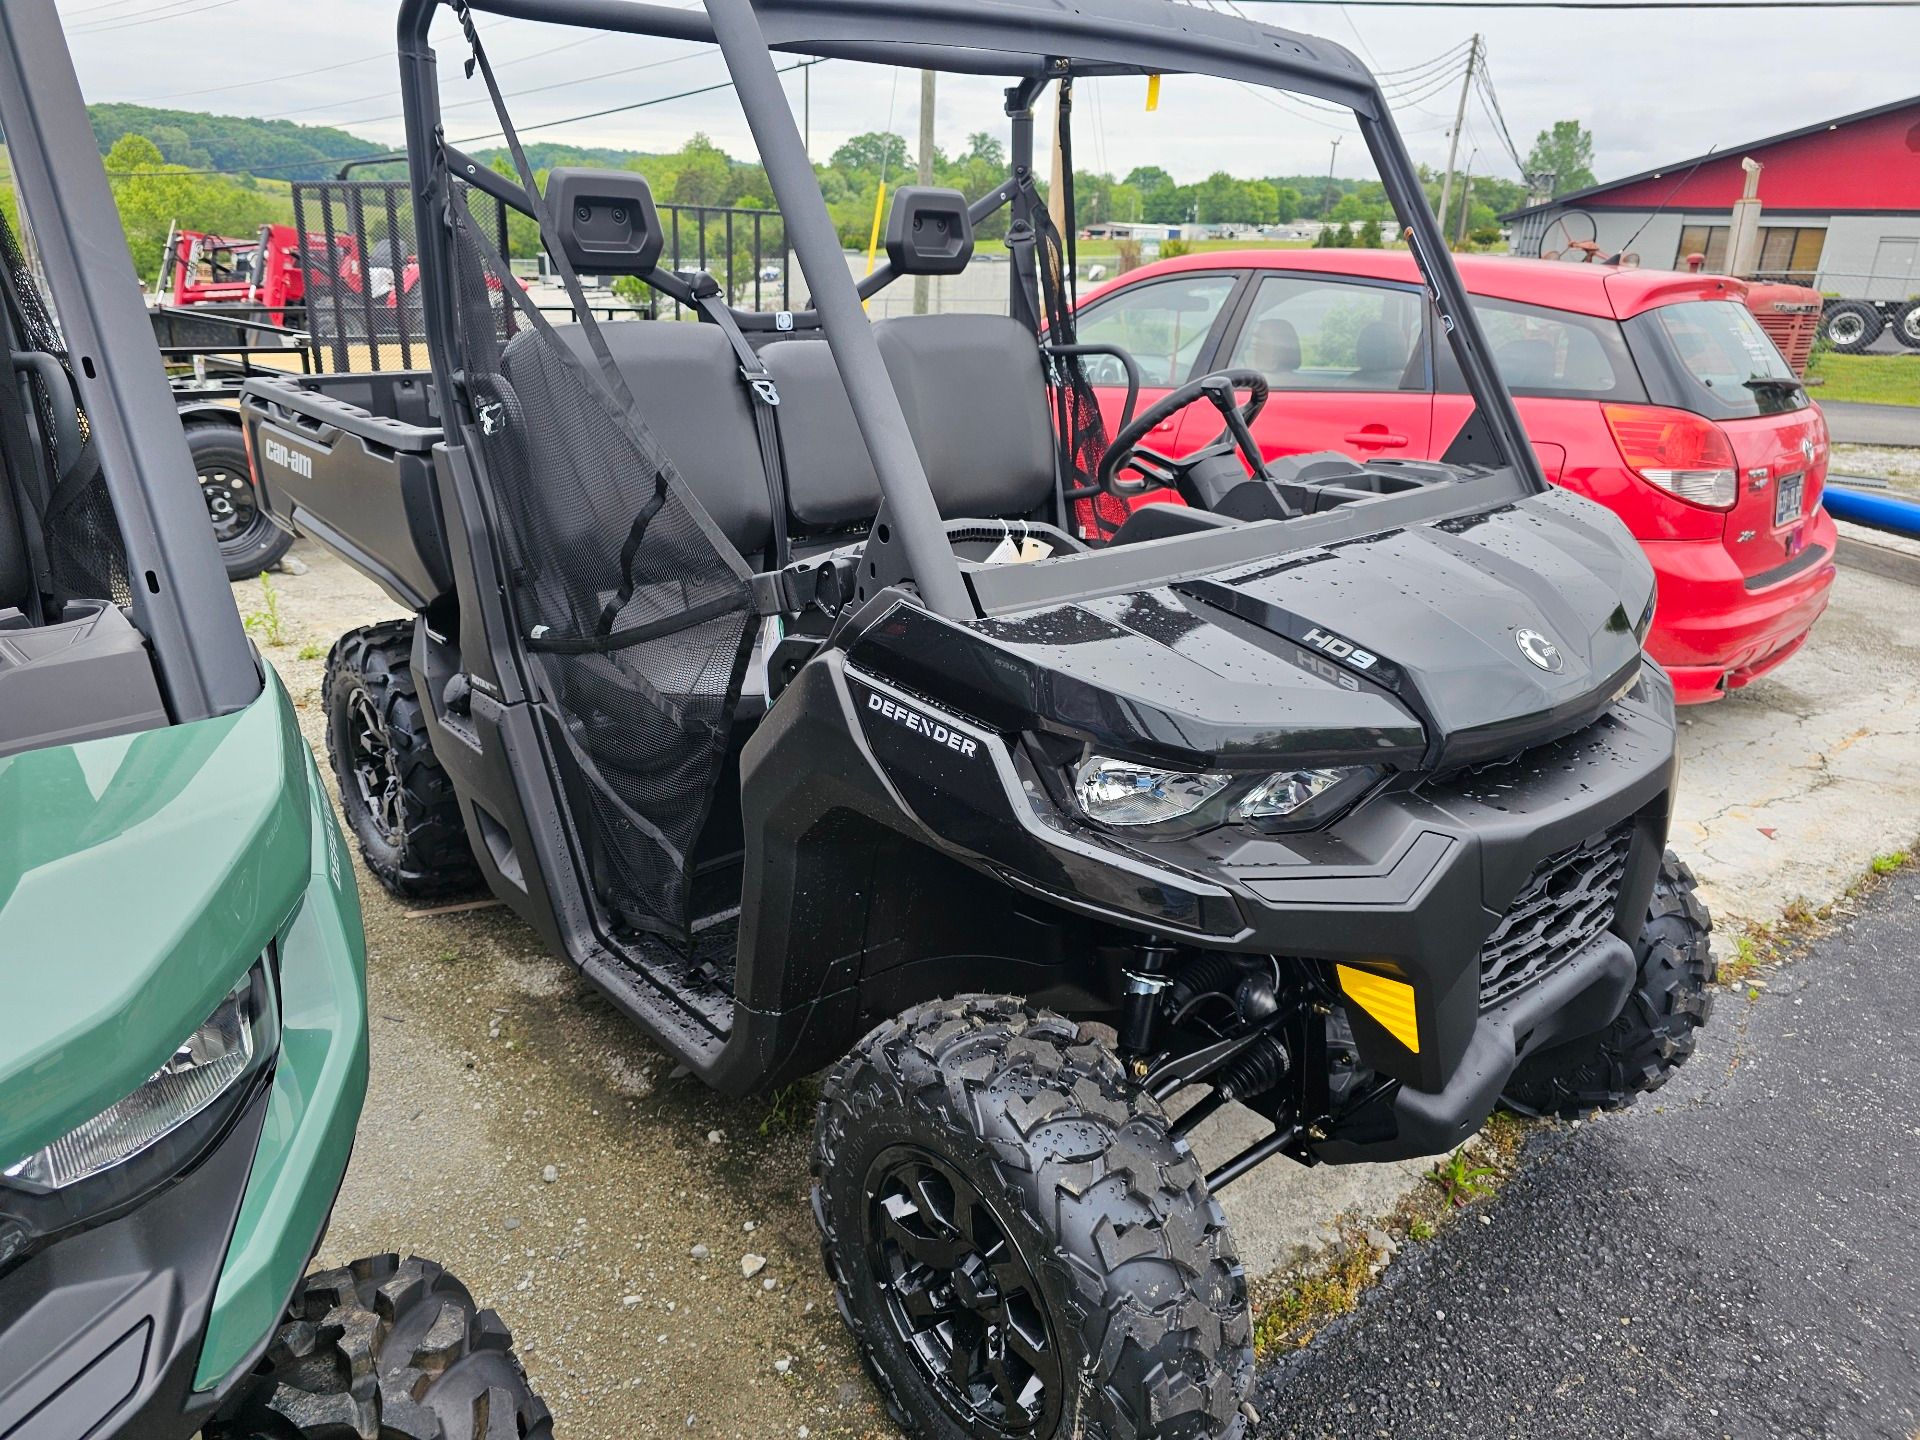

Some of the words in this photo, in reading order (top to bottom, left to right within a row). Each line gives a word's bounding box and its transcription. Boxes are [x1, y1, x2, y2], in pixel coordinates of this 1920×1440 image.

[265, 438, 312, 479] can-am
[1302, 627, 1378, 670] HD9
[1542, 646, 1556, 657] BRP
[868, 693, 978, 758] DEFENDER
